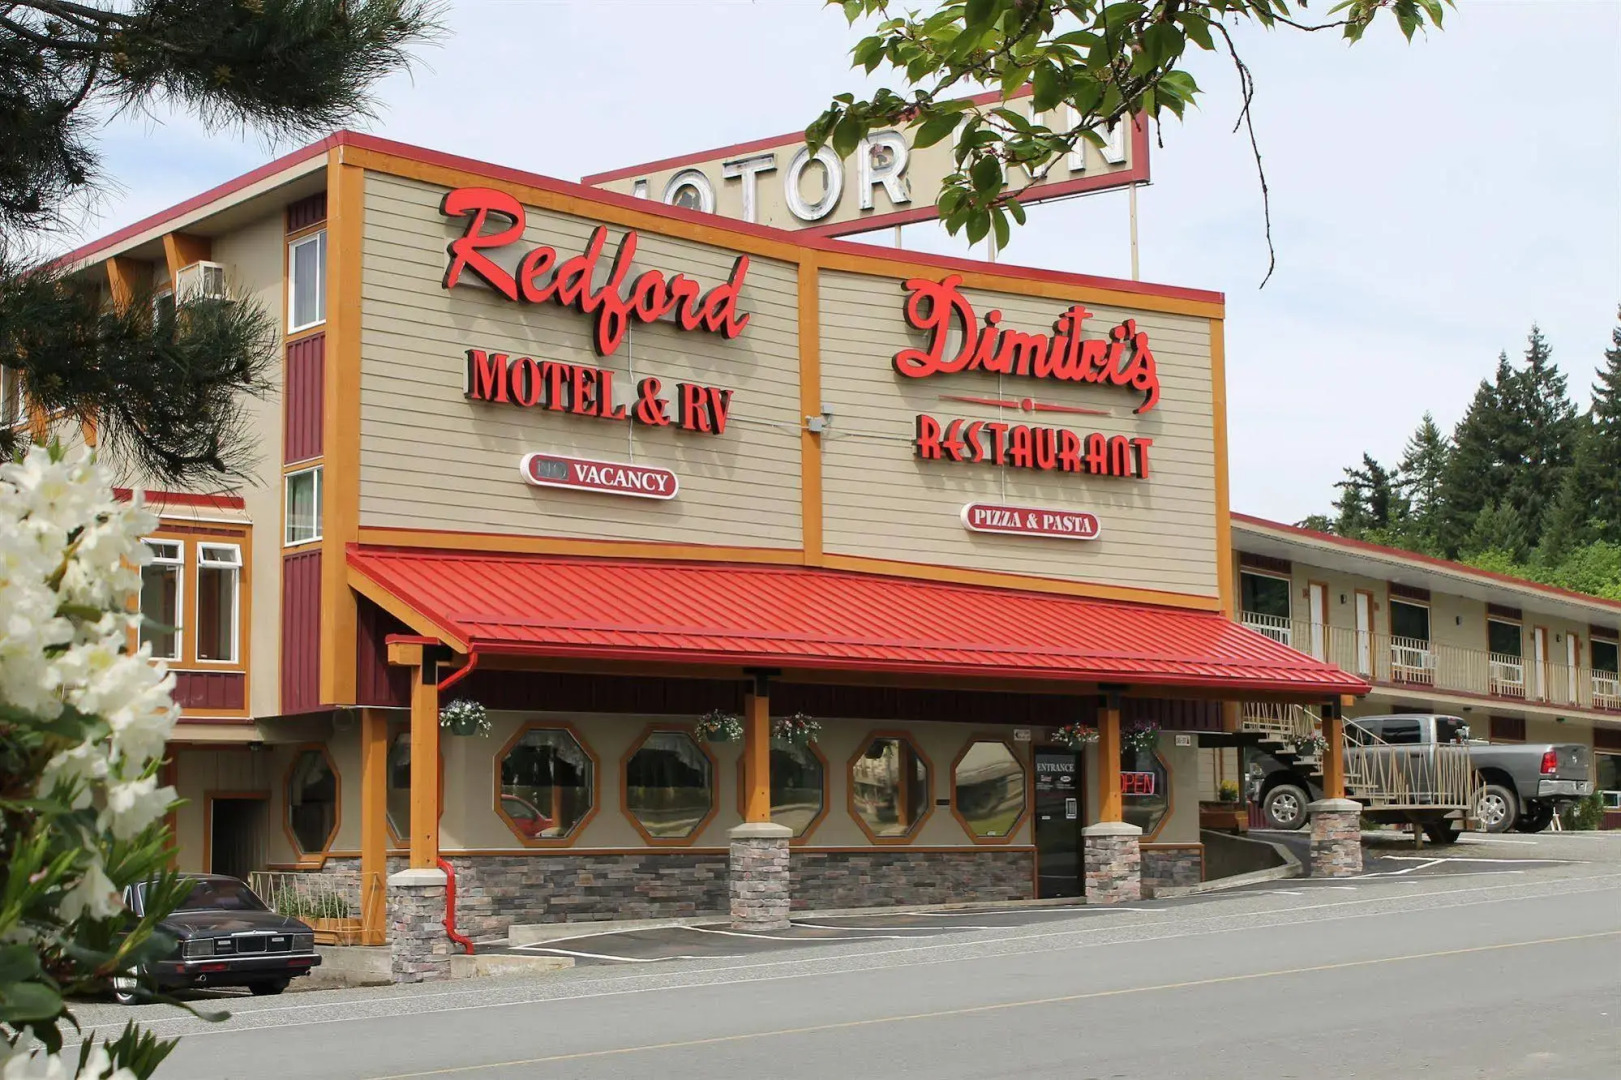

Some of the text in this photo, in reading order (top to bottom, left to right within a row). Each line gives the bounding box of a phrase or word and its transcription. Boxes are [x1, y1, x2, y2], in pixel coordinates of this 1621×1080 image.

[632, 131, 912, 222] OTOR
[440, 187, 750, 356] Redford
[892, 274, 1160, 414] Dimitri's
[465, 349, 735, 434] MOTEL & RV
[574, 464, 668, 492] VACANCY
[914, 414, 1153, 479] RESTAURANT
[974, 509, 1092, 533] PIZZA & PASTA
[1036, 763, 1075, 773] ENTRANCE
